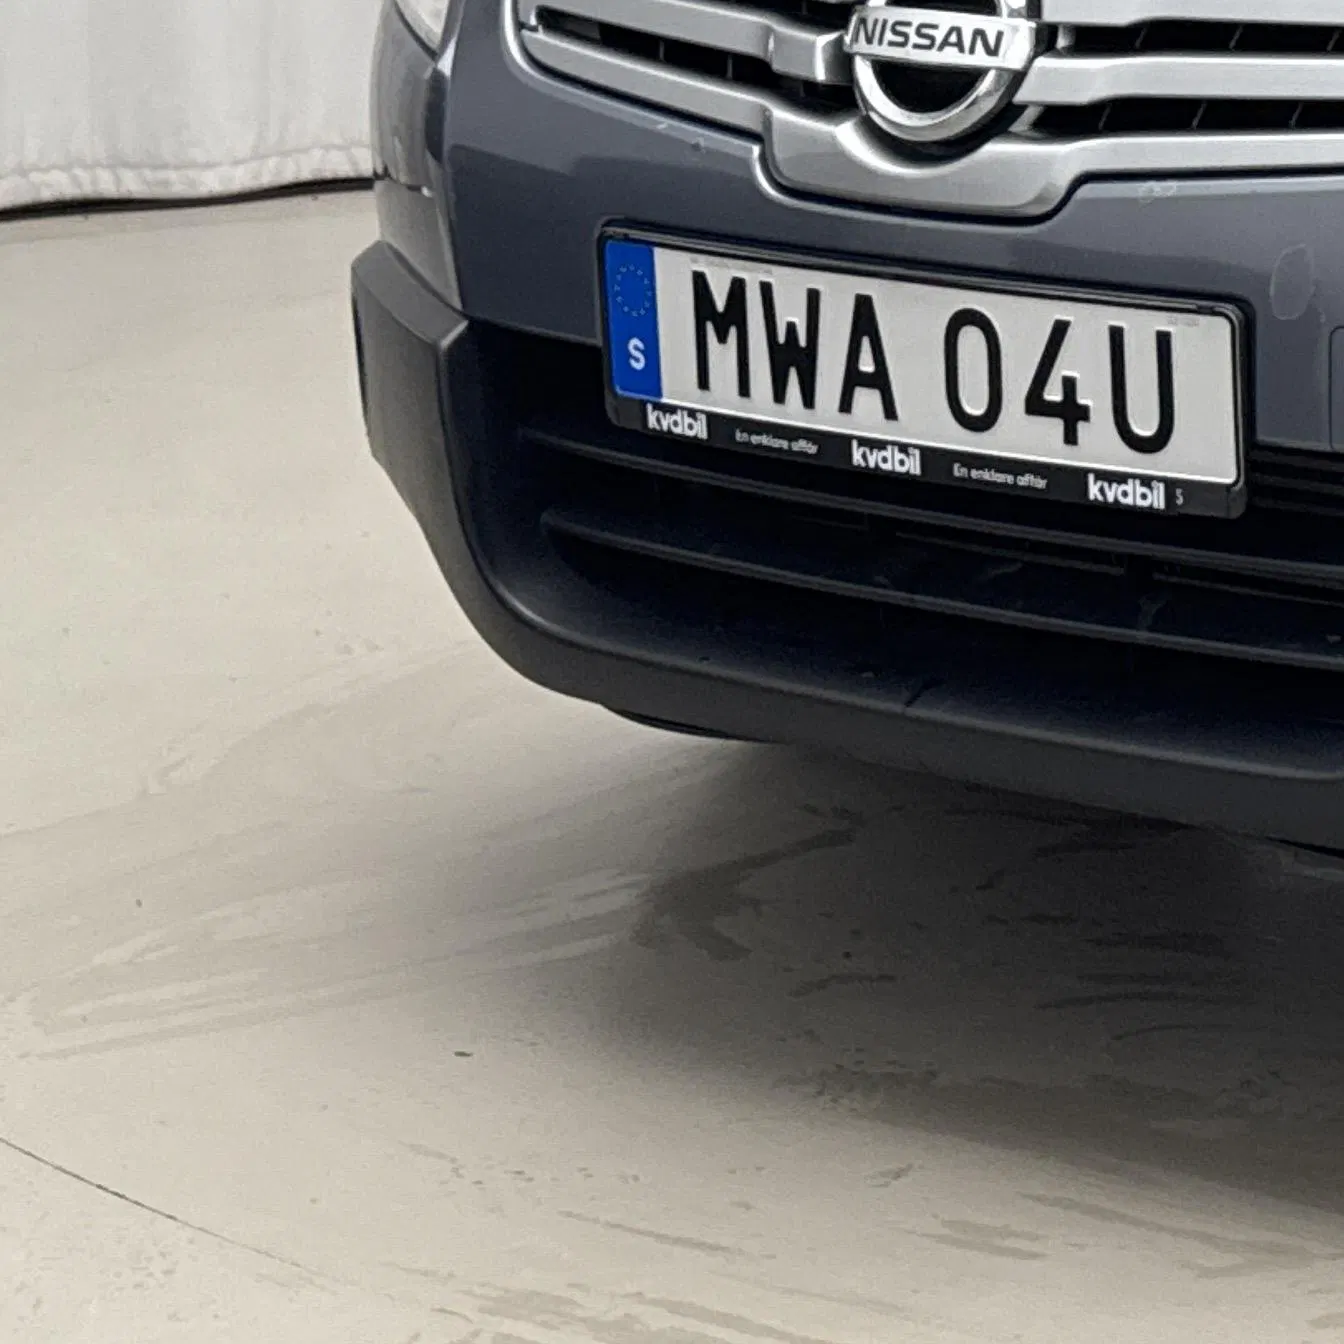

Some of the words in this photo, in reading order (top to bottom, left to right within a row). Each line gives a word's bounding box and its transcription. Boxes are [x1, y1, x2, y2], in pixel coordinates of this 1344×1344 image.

[853, 17, 1005, 57] NISSAN
[628, 337, 645, 370] S
[691, 269, 899, 422] MWA
[646, 404, 708, 440] kvdbil
[851, 439, 921, 476] kvdbil
[1087, 472, 1166, 510] kvdbil
